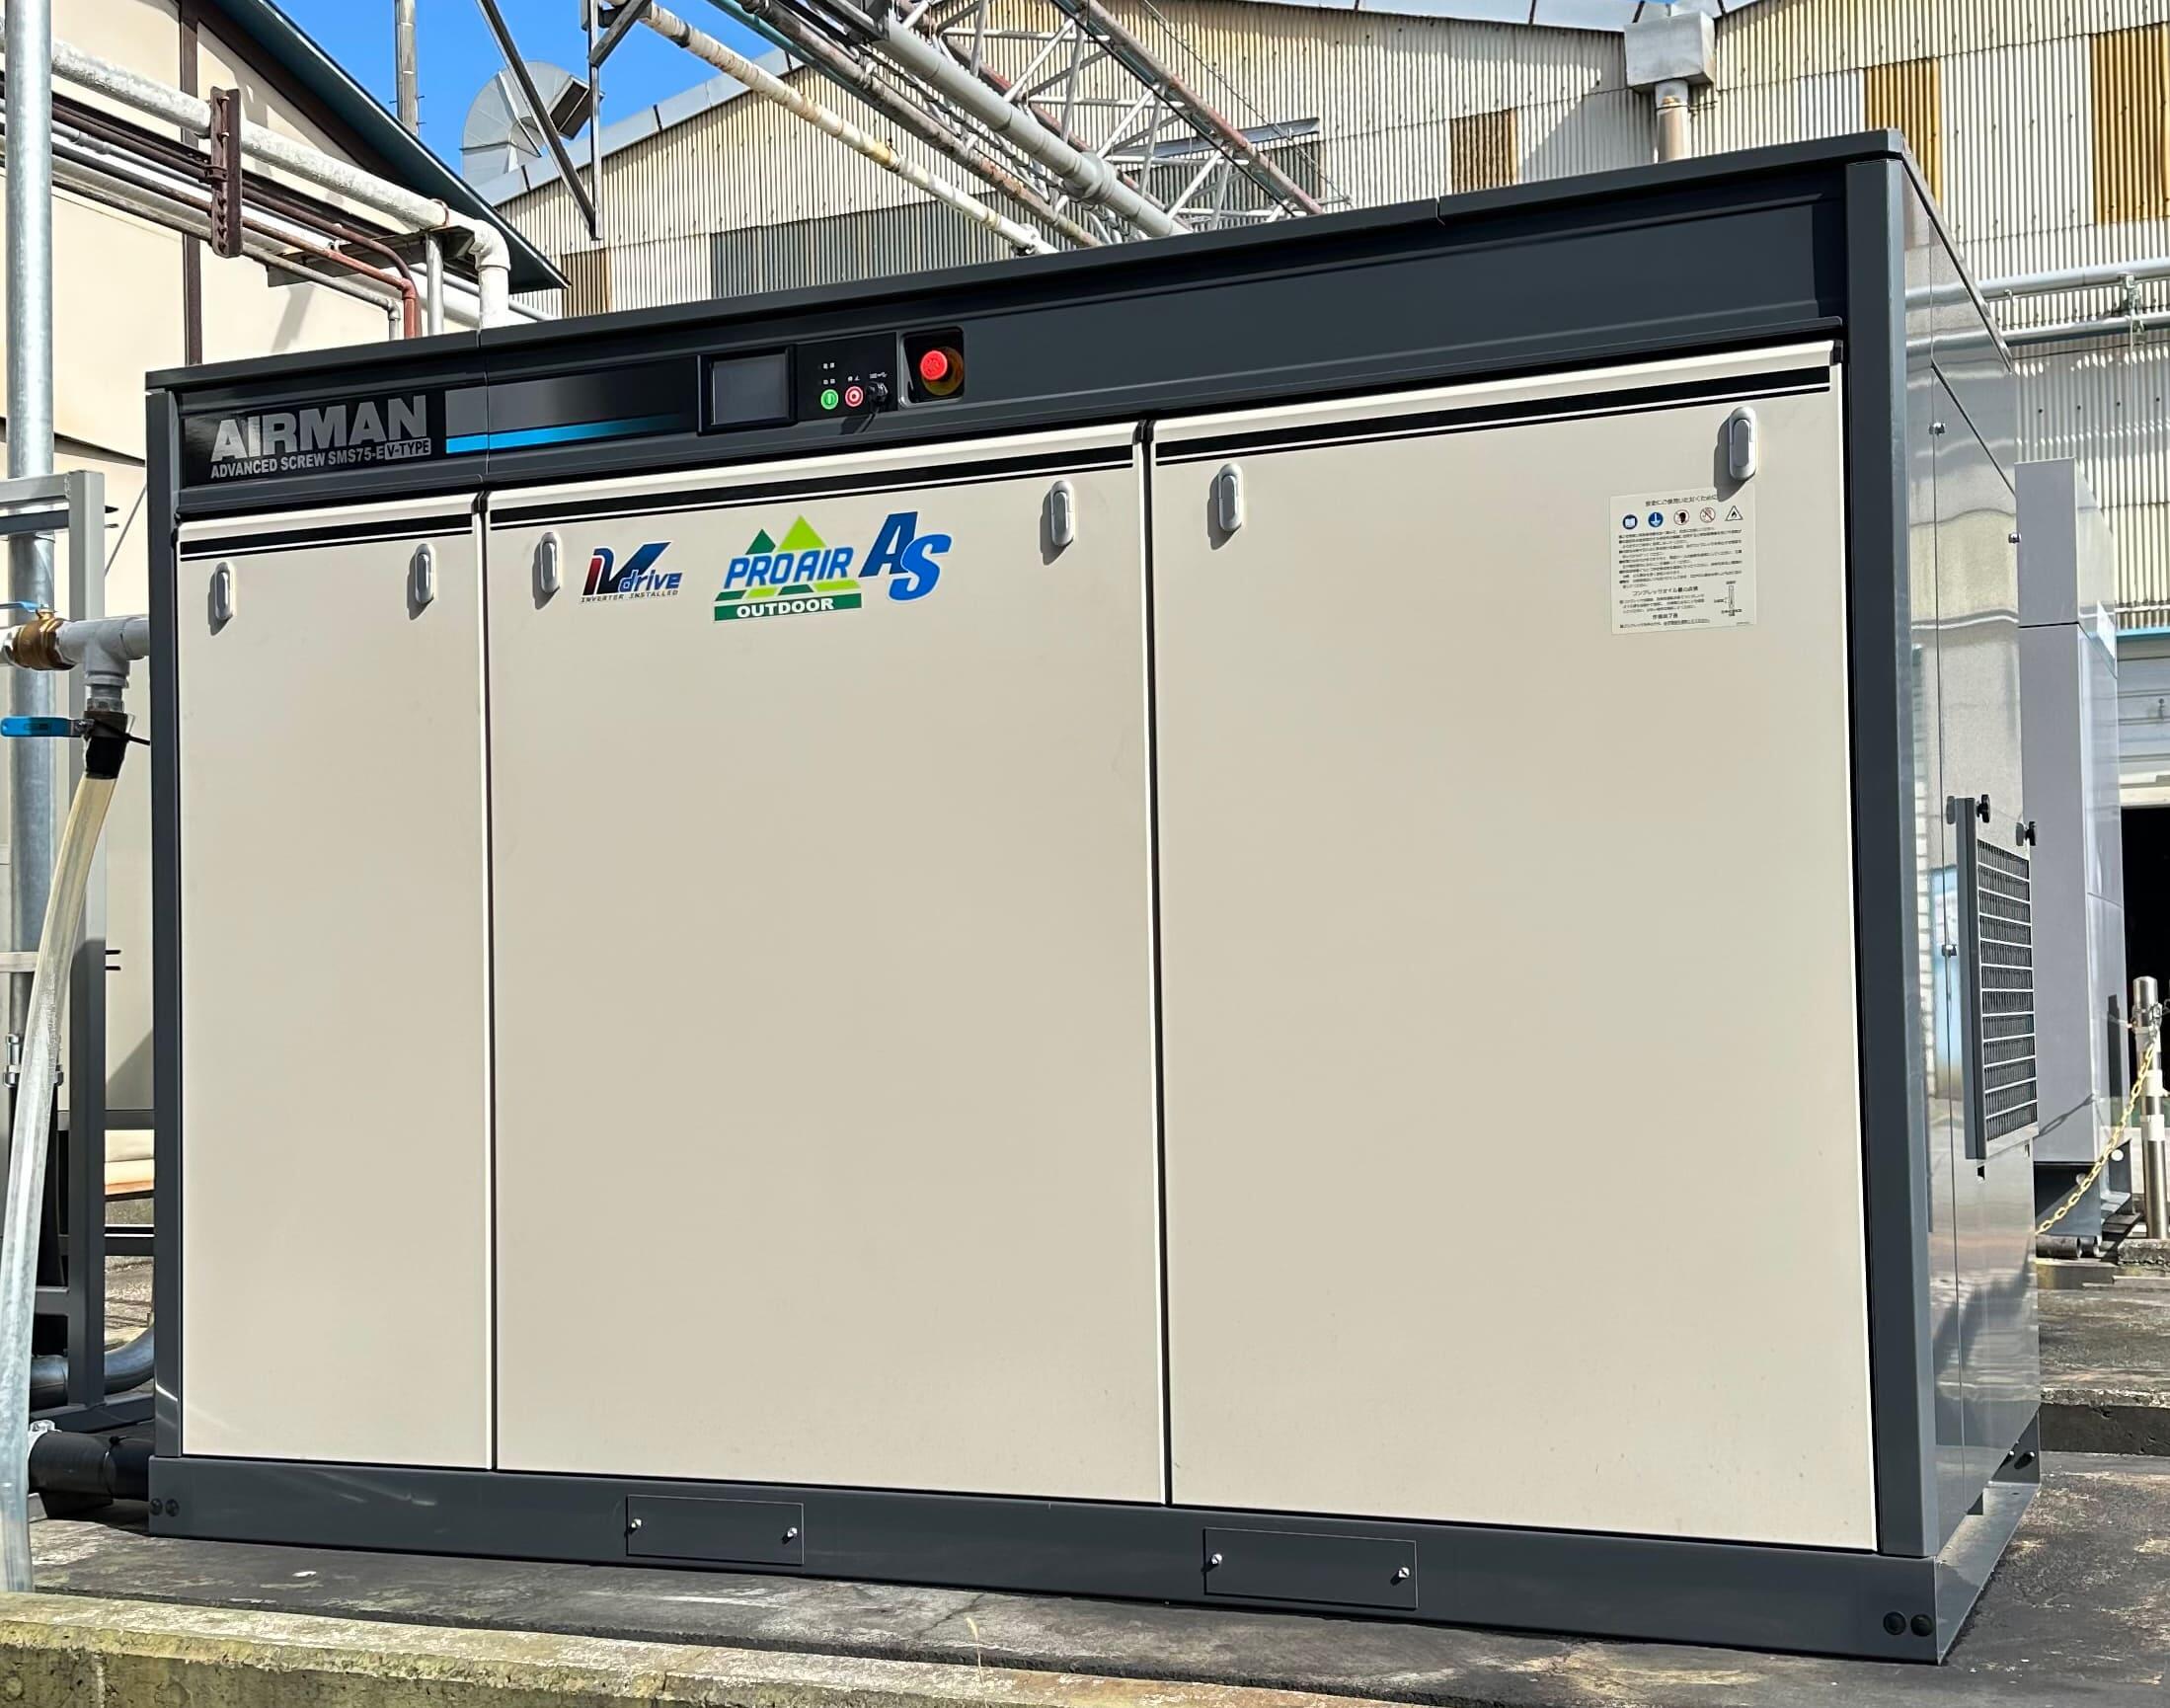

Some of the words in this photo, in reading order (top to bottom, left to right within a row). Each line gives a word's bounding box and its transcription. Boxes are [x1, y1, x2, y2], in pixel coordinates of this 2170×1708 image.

[210, 395, 427, 462] AIRMAN
[210, 457, 277, 479] ADVANCED
[280, 452, 325, 471] SCREW
[618, 569, 683, 593] drive
[629, 589, 679, 600] INSTALLED
[736, 597, 834, 618] OUTDOOR
